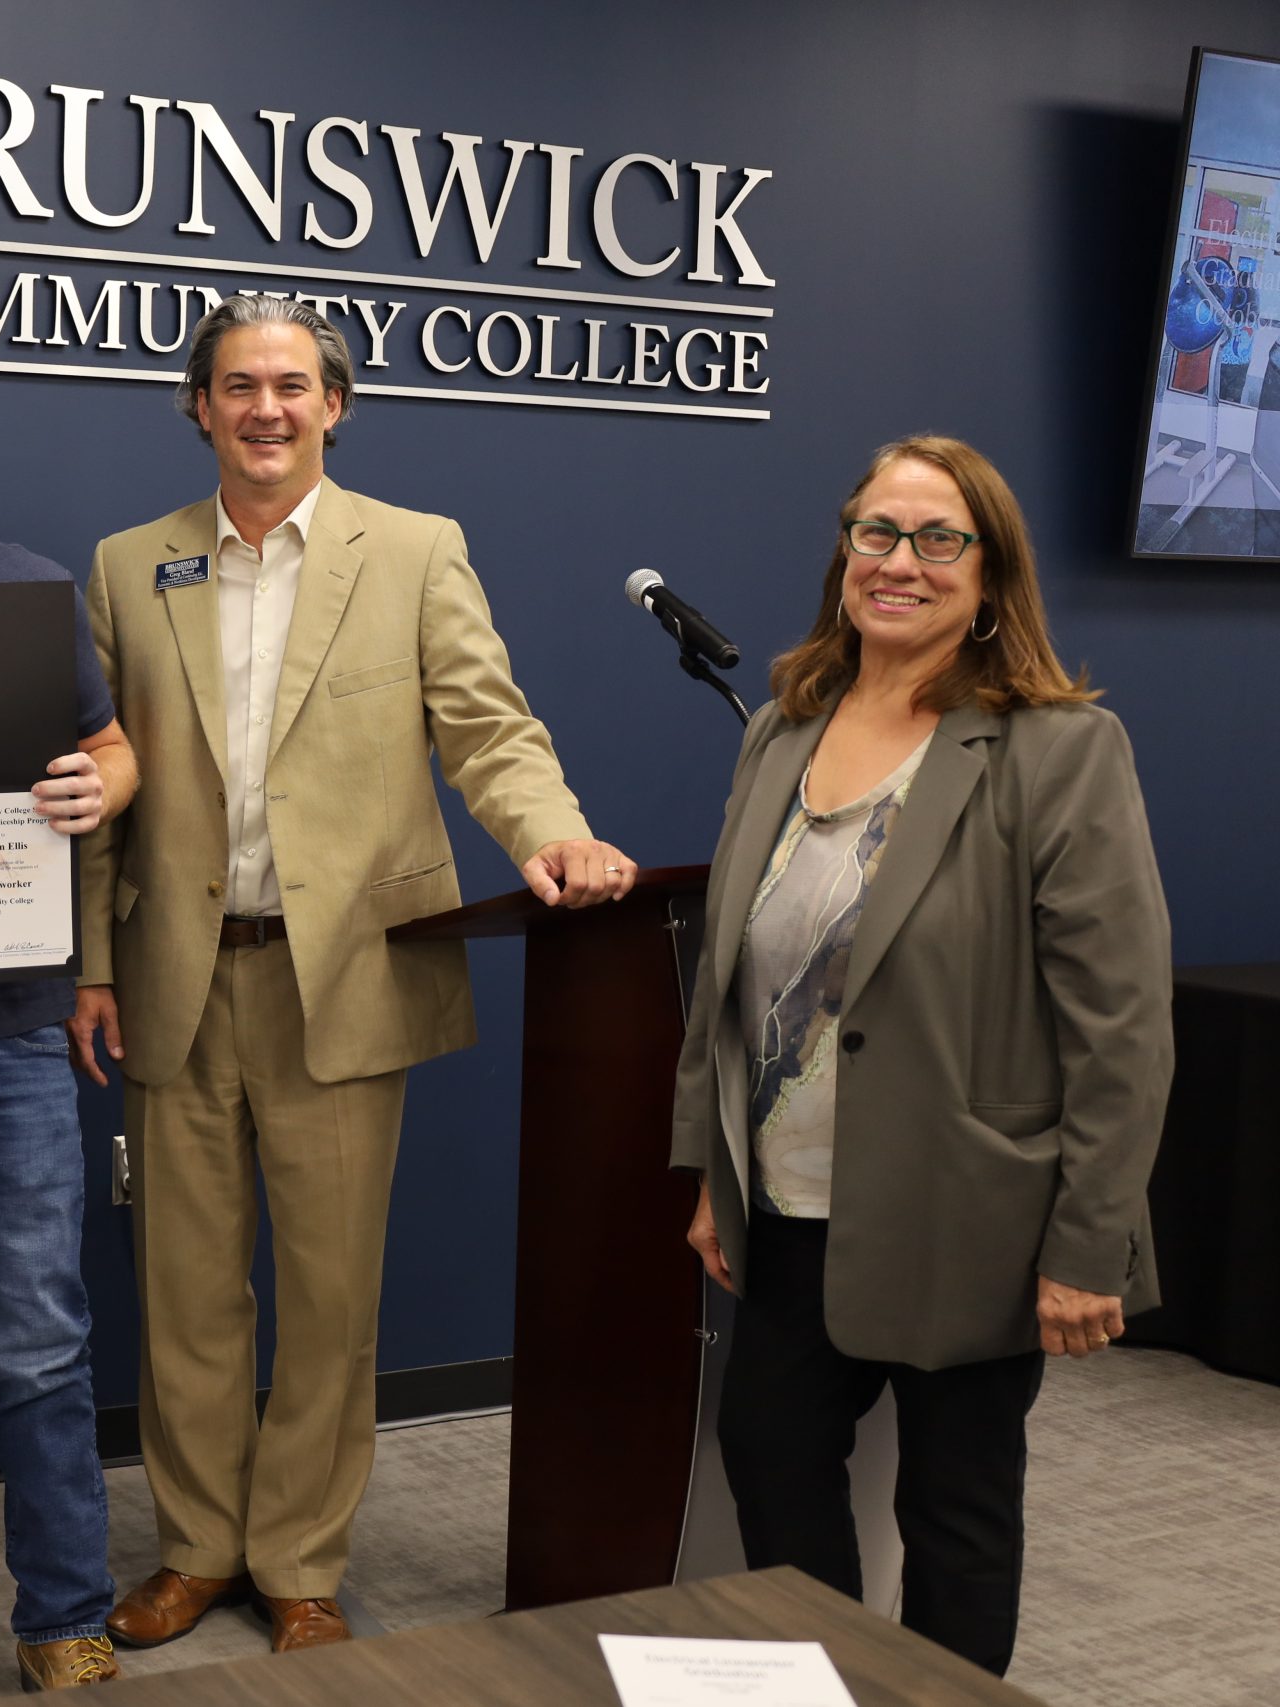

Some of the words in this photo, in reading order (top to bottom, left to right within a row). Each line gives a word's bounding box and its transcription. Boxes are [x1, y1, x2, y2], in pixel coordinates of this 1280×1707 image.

[422, 306, 770, 395] COLLEGE
[4, 807, 30, 815] College
[27, 816, 49, 826] Progr
[8, 841, 28, 851] Ellis
[10, 897, 34, 905] College
